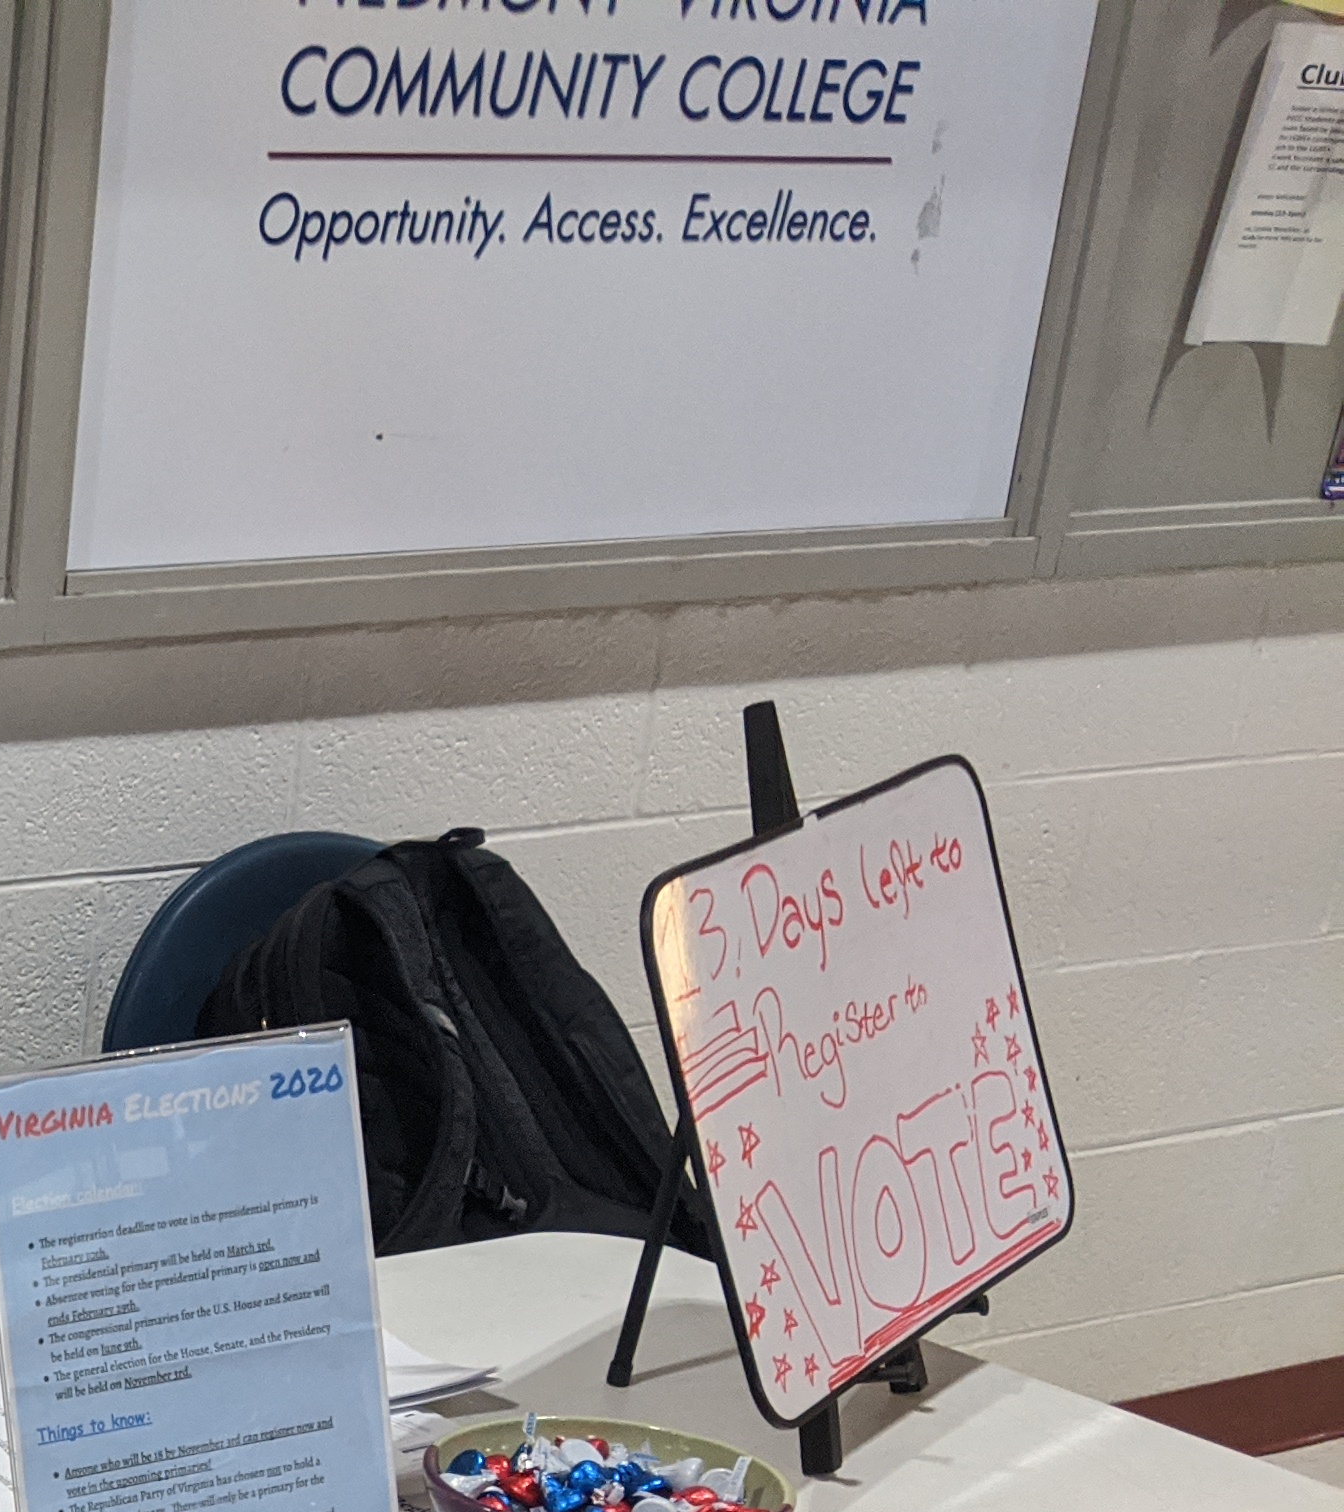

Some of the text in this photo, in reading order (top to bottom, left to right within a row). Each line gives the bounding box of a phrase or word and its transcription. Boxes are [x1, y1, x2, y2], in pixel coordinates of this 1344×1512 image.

[281, 45, 920, 123] COMMUNITY COLLEGE
[259, 189, 874, 261] Opportunity. Access. Excellence.
[741, 865, 844, 971] Days
[861, 840, 923, 919] left
[931, 837, 962, 874] to
[753, 987, 897, 1107] Register
[124, 1080, 261, 1122] ELECTIONS
[270, 1064, 342, 1099] 2020
[755, 1071, 1036, 1368] VOTE
[36, 1412, 152, 1445] Things to know:
